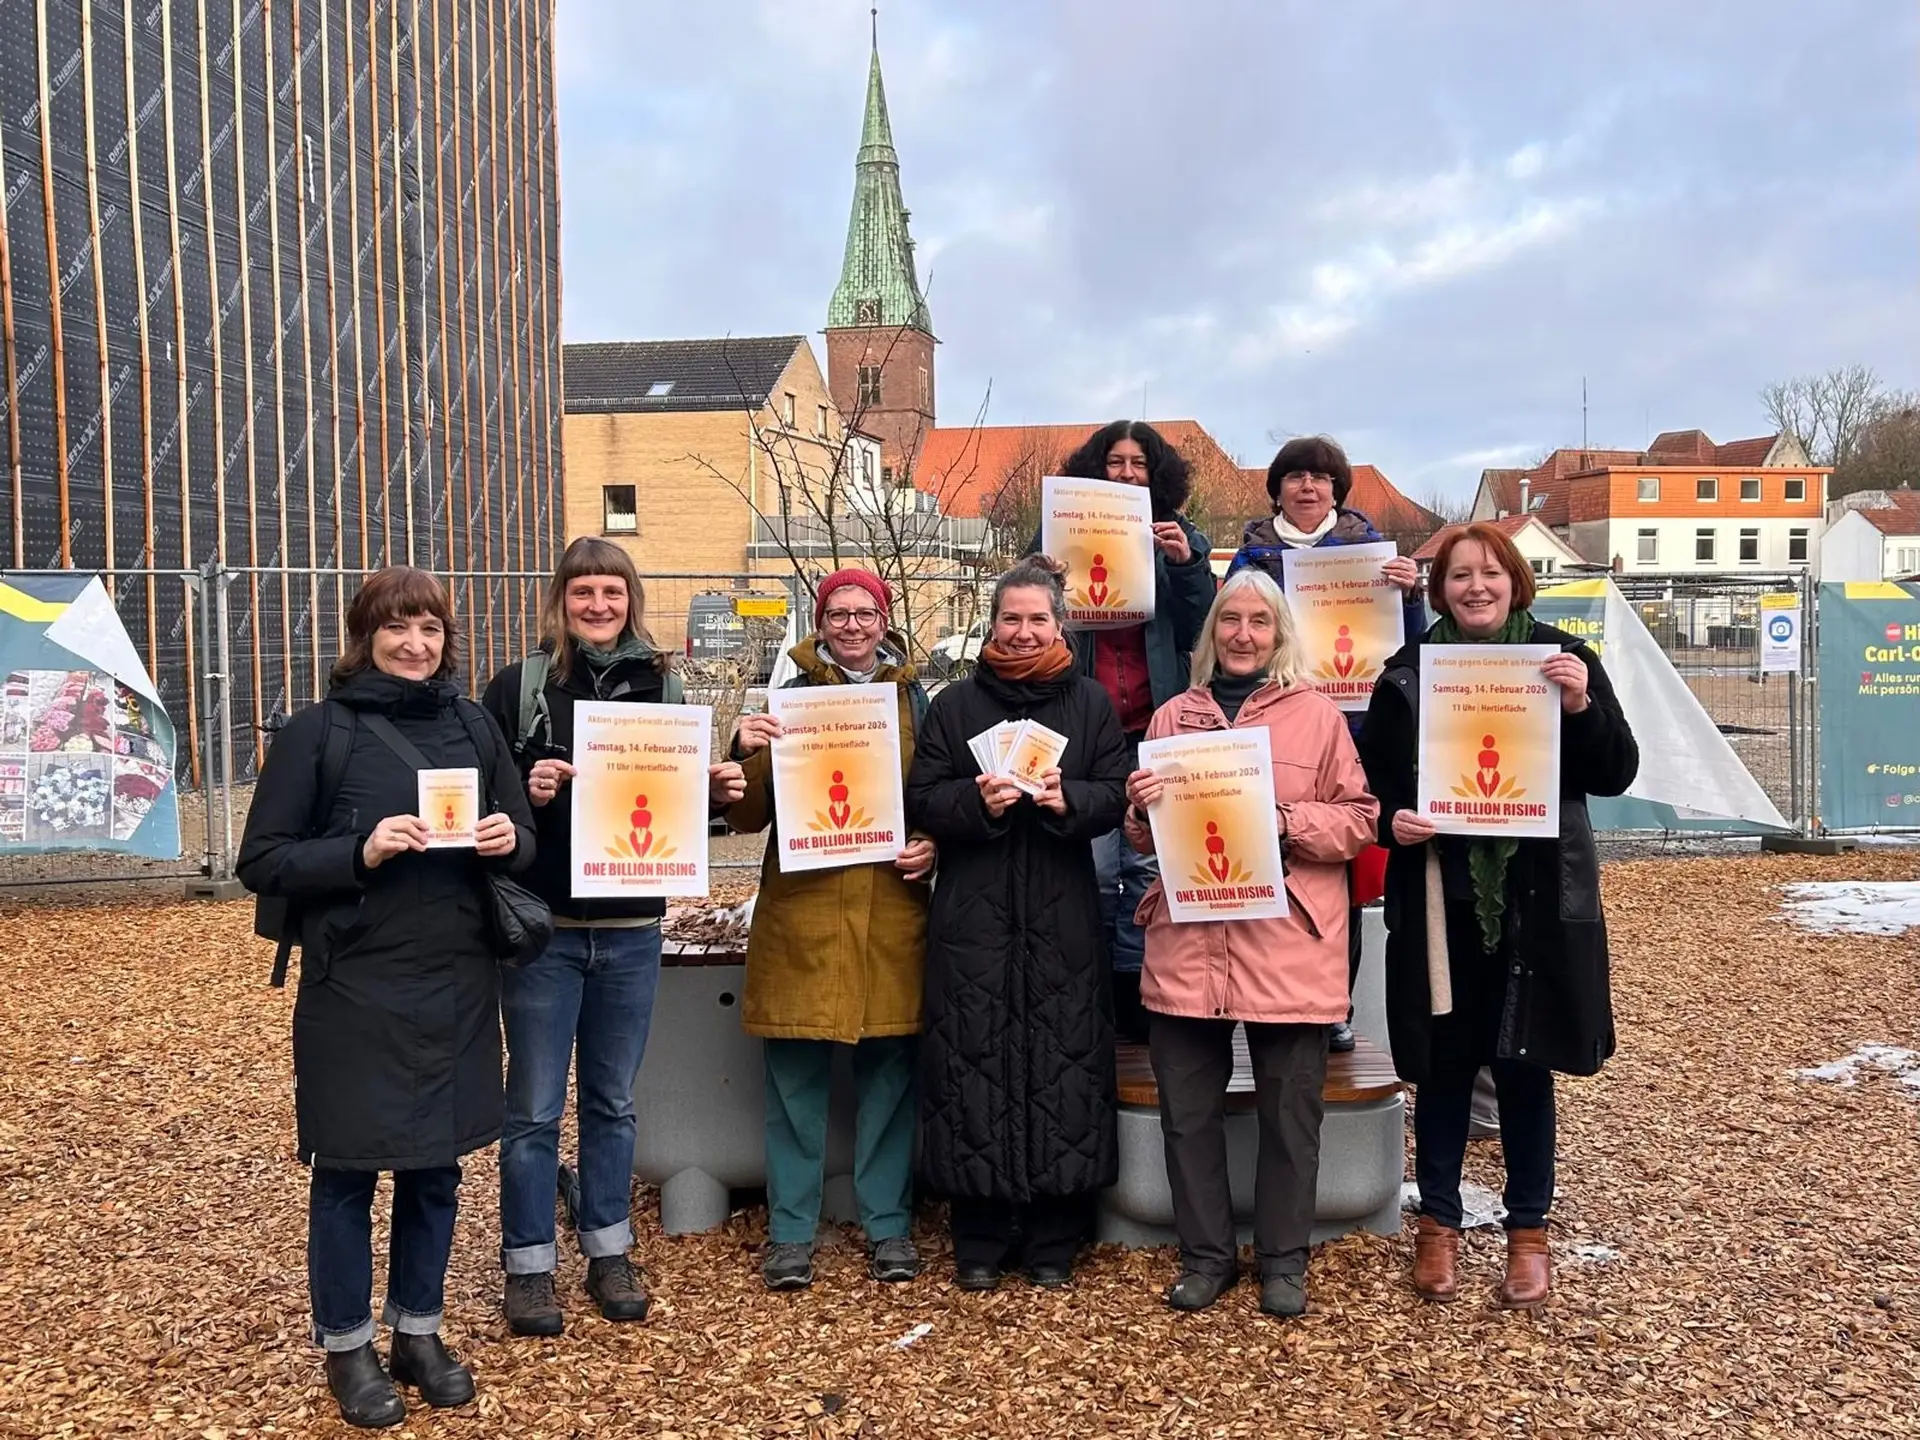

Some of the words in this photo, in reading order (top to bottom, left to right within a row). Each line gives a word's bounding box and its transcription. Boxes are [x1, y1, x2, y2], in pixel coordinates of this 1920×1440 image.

[53, 48, 83, 87] THERMO
[17, 169, 30, 189] ND
[104, 203, 116, 221] ND
[34, 344, 47, 364] ND
[119, 364, 131, 382] ND
[1053, 509, 1085, 520] Samstag,
[1087, 511, 1098, 519] 14.
[1100, 513, 1126, 521] Februar
[1077, 527, 1089, 536] Uhr
[1296, 583, 1328, 593] Samstag,
[1330, 581, 1340, 590] 14.
[1342, 580, 1369, 589] Februar
[1371, 578, 1389, 587] 2026
[1072, 610, 1109, 620] BILLION
[1111, 610, 1145, 620] RISING
[1558, 616, 1604, 635] Nähe:
[1875, 672, 1902, 683] Alles
[1357, 681, 1376, 693] RIS
[1432, 683, 1473, 695] Samstag,
[1475, 684, 1488, 694] 14.
[1490, 684, 1523, 694] Februar
[1525, 684, 1547, 695] 2026
[1859, 684, 1878, 695] Mit
[1452, 703, 1460, 712] 11
[1462, 704, 1476, 712] Uhr
[1481, 703, 1527, 713] Hertiefläche
[782, 725, 820, 735] Samstag,
[821, 723, 834, 733] 14.
[835, 722, 866, 732] Februar
[867, 720, 888, 730] 2026
[587, 741, 627, 754] Samstag,
[629, 743, 642, 753] 14.
[643, 743, 676, 754] Februar
[677, 745, 698, 755] 2026
[802, 743, 810, 751] 11
[811, 742, 824, 751] Uhr
[606, 762, 615, 771] 11
[616, 762, 630, 771] Uhr
[1191, 772, 1204, 781] 14.
[1205, 771, 1237, 780] Februar
[1239, 766, 1260, 777] 2026
[1883, 764, 1916, 776] Folge
[1174, 793, 1182, 802] 11
[1183, 792, 1195, 801] Uhr
[1430, 800, 1453, 814] ONE
[1454, 801, 1501, 816] BILLION
[1503, 803, 1547, 817] RISING
[789, 837, 810, 851] ONE
[811, 833, 853, 849] BILLION
[855, 829, 894, 845] RISING
[583, 862, 607, 876] ONE
[608, 862, 654, 876] BILLION
[656, 862, 697, 876] RISING
[1175, 890, 1196, 903] ONE
[1196, 887, 1236, 902] BILLION
[1238, 885, 1275, 899] RISING
